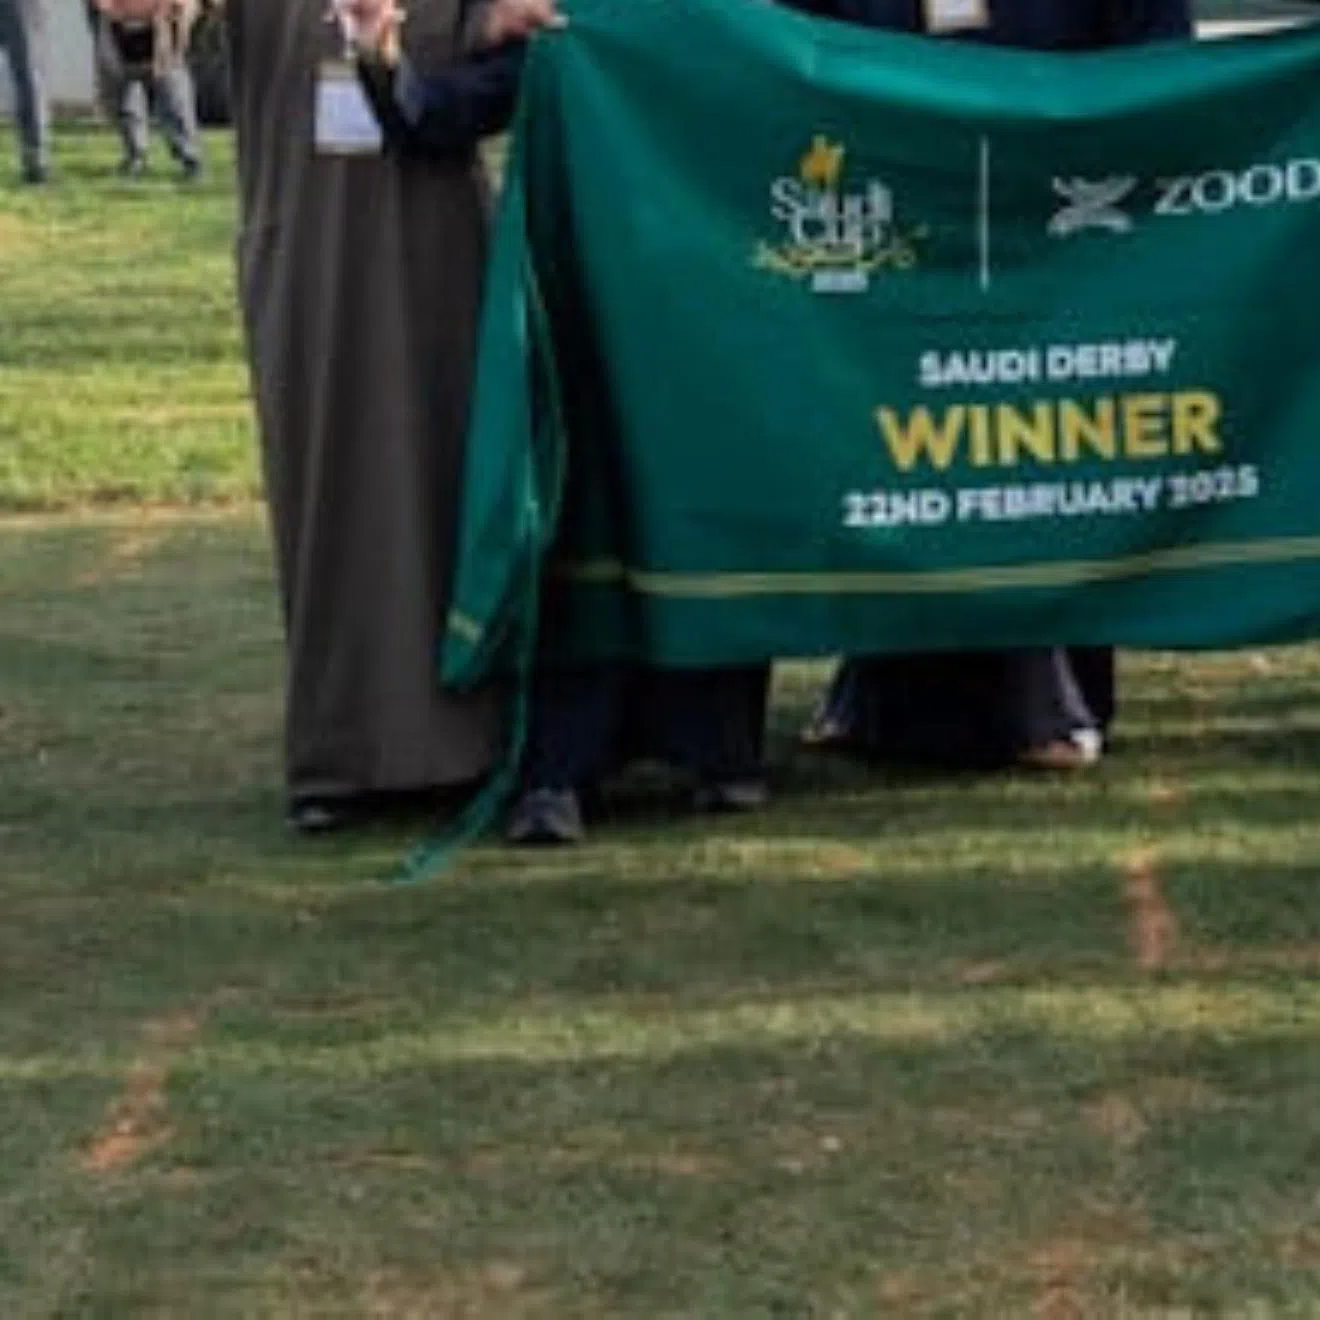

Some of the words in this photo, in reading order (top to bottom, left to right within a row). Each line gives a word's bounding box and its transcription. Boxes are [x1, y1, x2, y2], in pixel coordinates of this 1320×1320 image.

[920, 347, 1039, 386] SAUDI
[1047, 338, 1177, 379] DERBY
[876, 388, 1223, 472] WINNER
[842, 487, 949, 527] 22ND
[957, 477, 1163, 524] FEBRUARY
